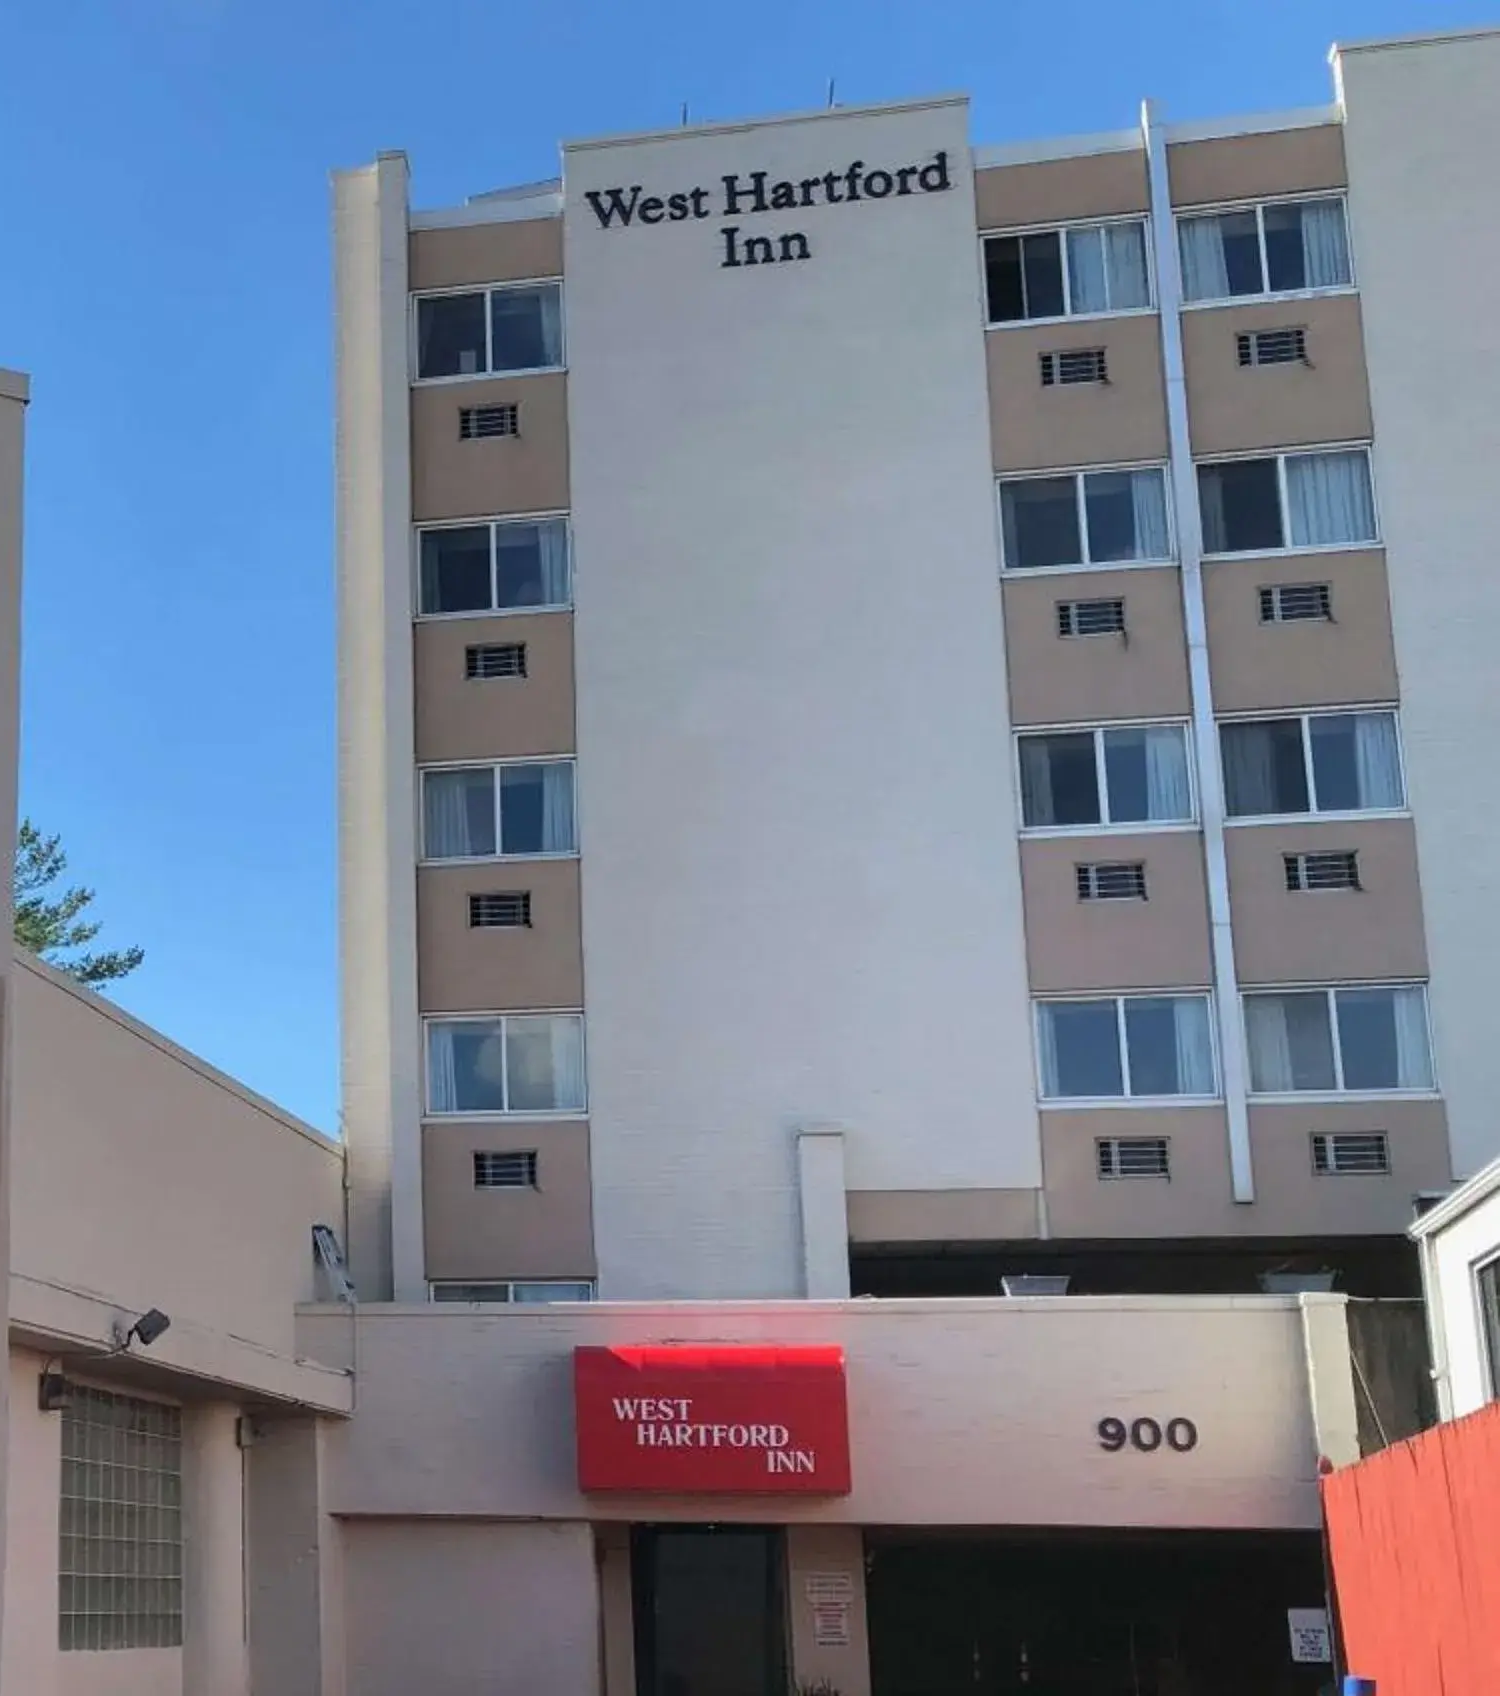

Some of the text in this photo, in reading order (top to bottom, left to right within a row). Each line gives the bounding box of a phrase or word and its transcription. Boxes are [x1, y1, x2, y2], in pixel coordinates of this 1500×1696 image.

[586, 151, 951, 228] West Hartford
[720, 226, 812, 268] Inn
[612, 1398, 692, 1421] WEST
[637, 1424, 789, 1447] HARTFORD
[1098, 1417, 1198, 1452] 900
[767, 1451, 815, 1473] INN
